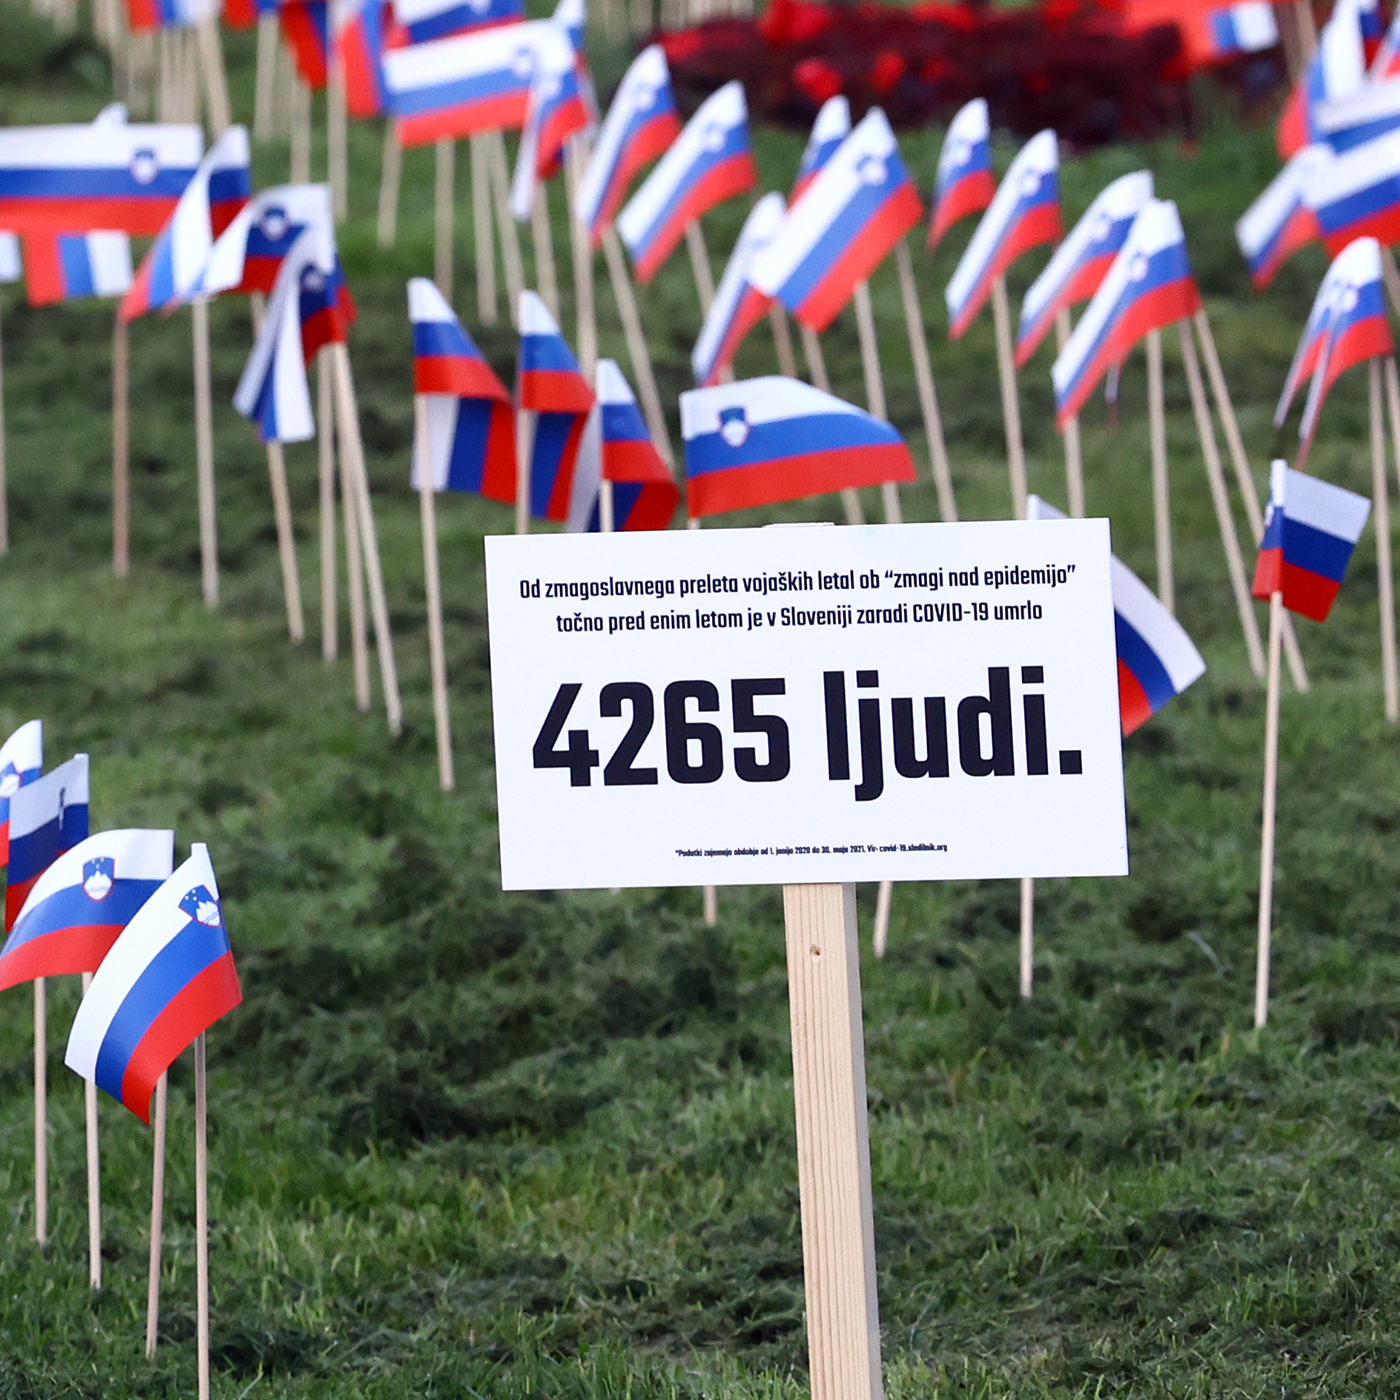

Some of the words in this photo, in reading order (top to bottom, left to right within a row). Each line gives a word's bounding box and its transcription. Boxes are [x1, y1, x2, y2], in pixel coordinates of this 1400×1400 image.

[520, 579, 540, 598] Od
[545, 577, 674, 601] zmagoslavnega
[680, 574, 738, 597] preleta
[743, 571, 813, 596] vojaških
[818, 570, 854, 590] letal
[860, 569, 880, 589] ob
[885, 567, 943, 591] “zmagi
[949, 566, 979, 587] nad
[984, 564, 1076, 589] epidemijo”
[556, 612, 603, 632] točno
[609, 611, 645, 634] pred
[651, 610, 691, 630] enim
[696, 609, 743, 629] letom
[748, 607, 763, 631] je
[767, 611, 777, 627] v
[781, 605, 852, 628] Sloveniji
[857, 603, 908, 625] zaradi
[913, 602, 989, 623] COVID-19
[994, 600, 1043, 620] umrlo
[532, 678, 791, 787] 4265
[823, 665, 1083, 801] ljudi.
[761, 847, 768, 855] od
